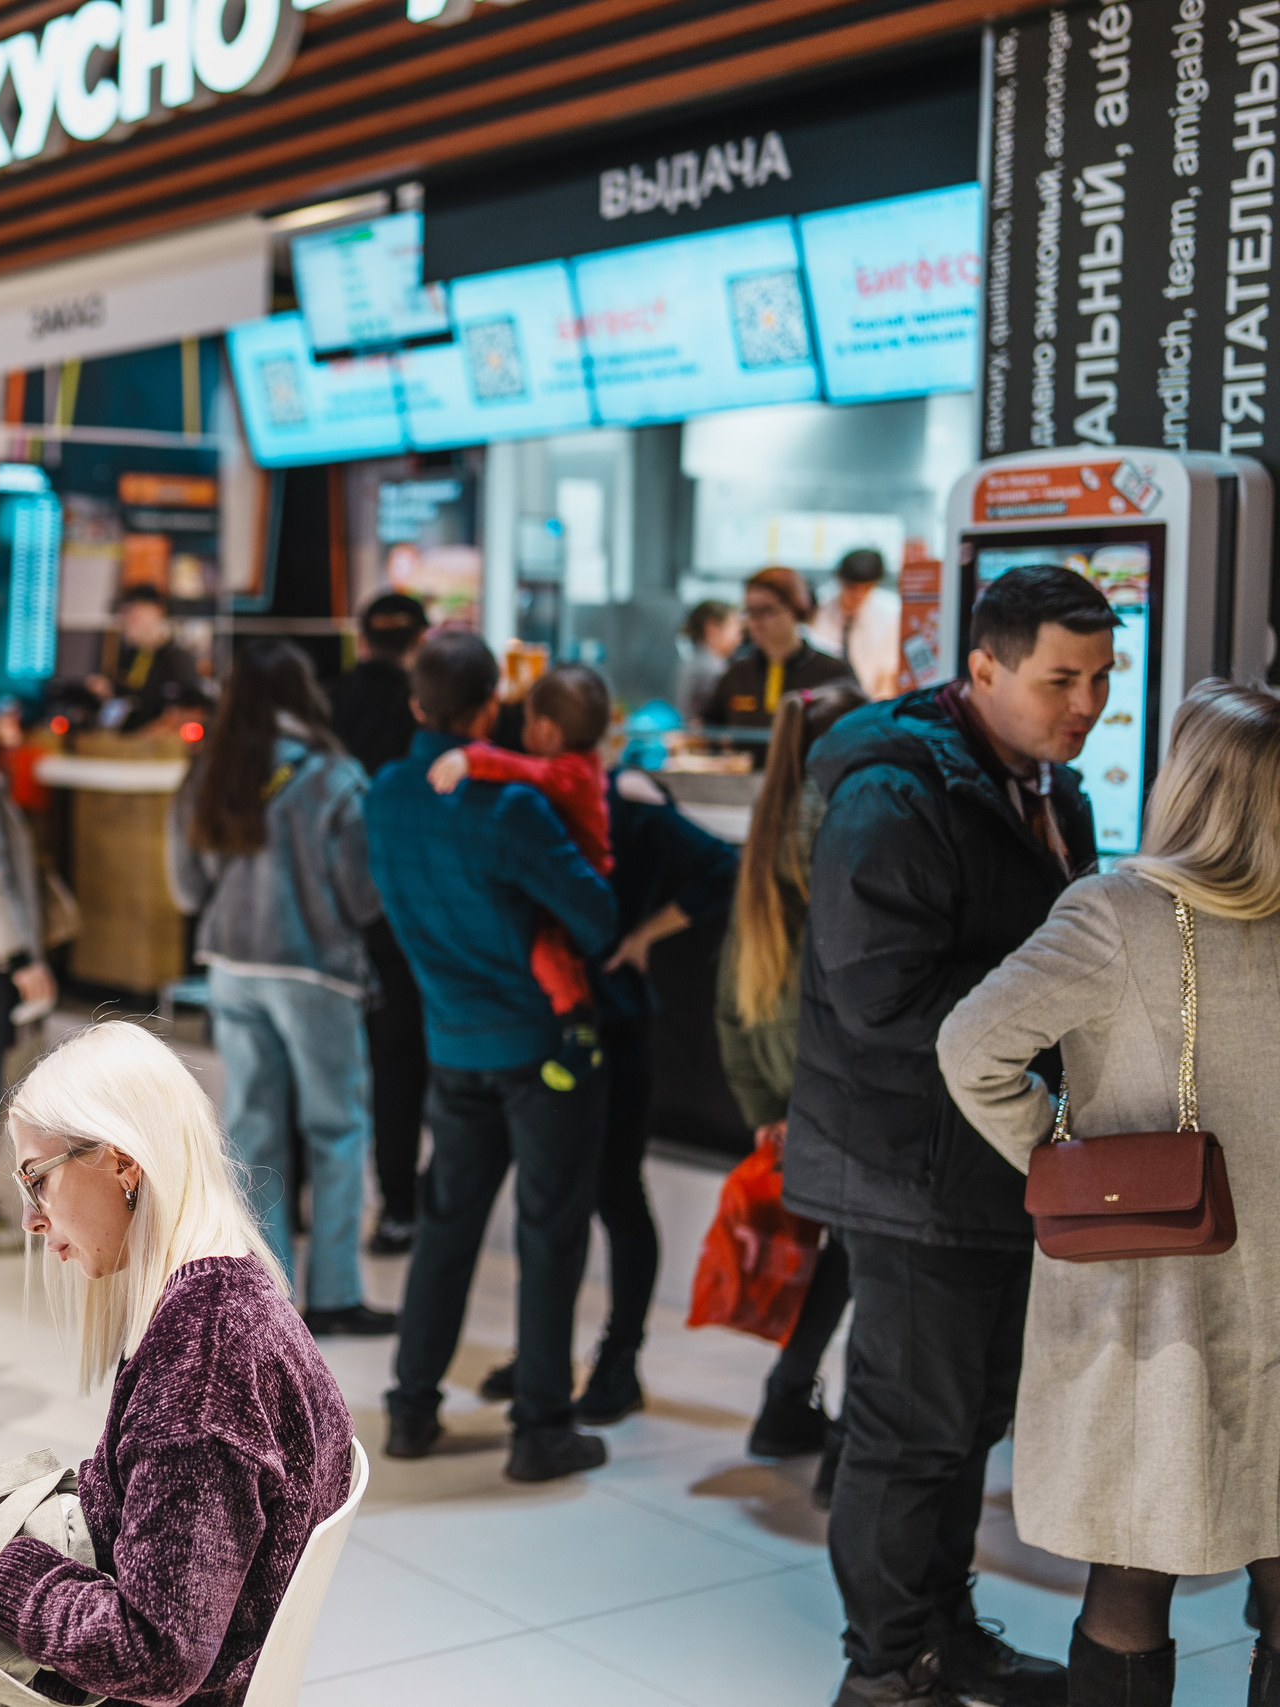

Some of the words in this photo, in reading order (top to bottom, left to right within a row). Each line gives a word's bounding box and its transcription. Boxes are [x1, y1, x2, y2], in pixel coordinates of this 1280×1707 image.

[1087, 0, 1132, 128] auté
[598, 130, 793, 221] ВЫДАЧА
[1034, 160, 1066, 341] ЗНАКОМЫЙ,
[1162, 186, 1203, 300] team,
